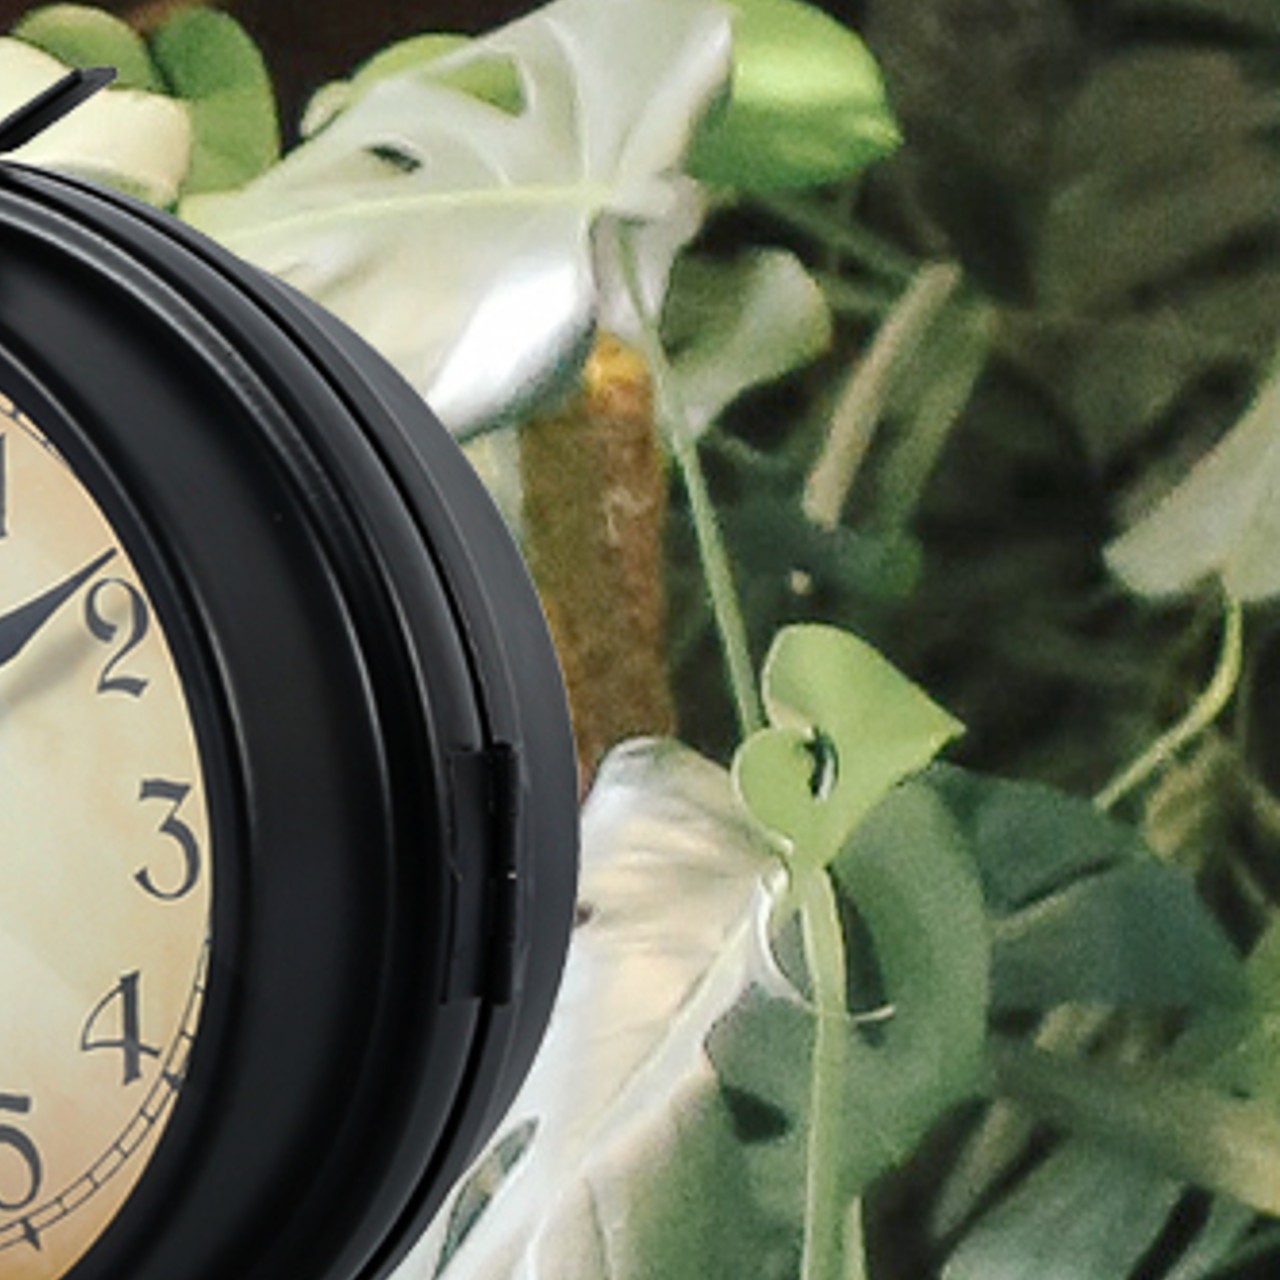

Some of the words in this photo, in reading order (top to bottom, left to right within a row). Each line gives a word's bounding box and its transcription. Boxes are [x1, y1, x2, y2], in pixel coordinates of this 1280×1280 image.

[84, 577, 150, 698] 2
[134, 778, 201, 901] 3
[80, 970, 162, 1085] 4
